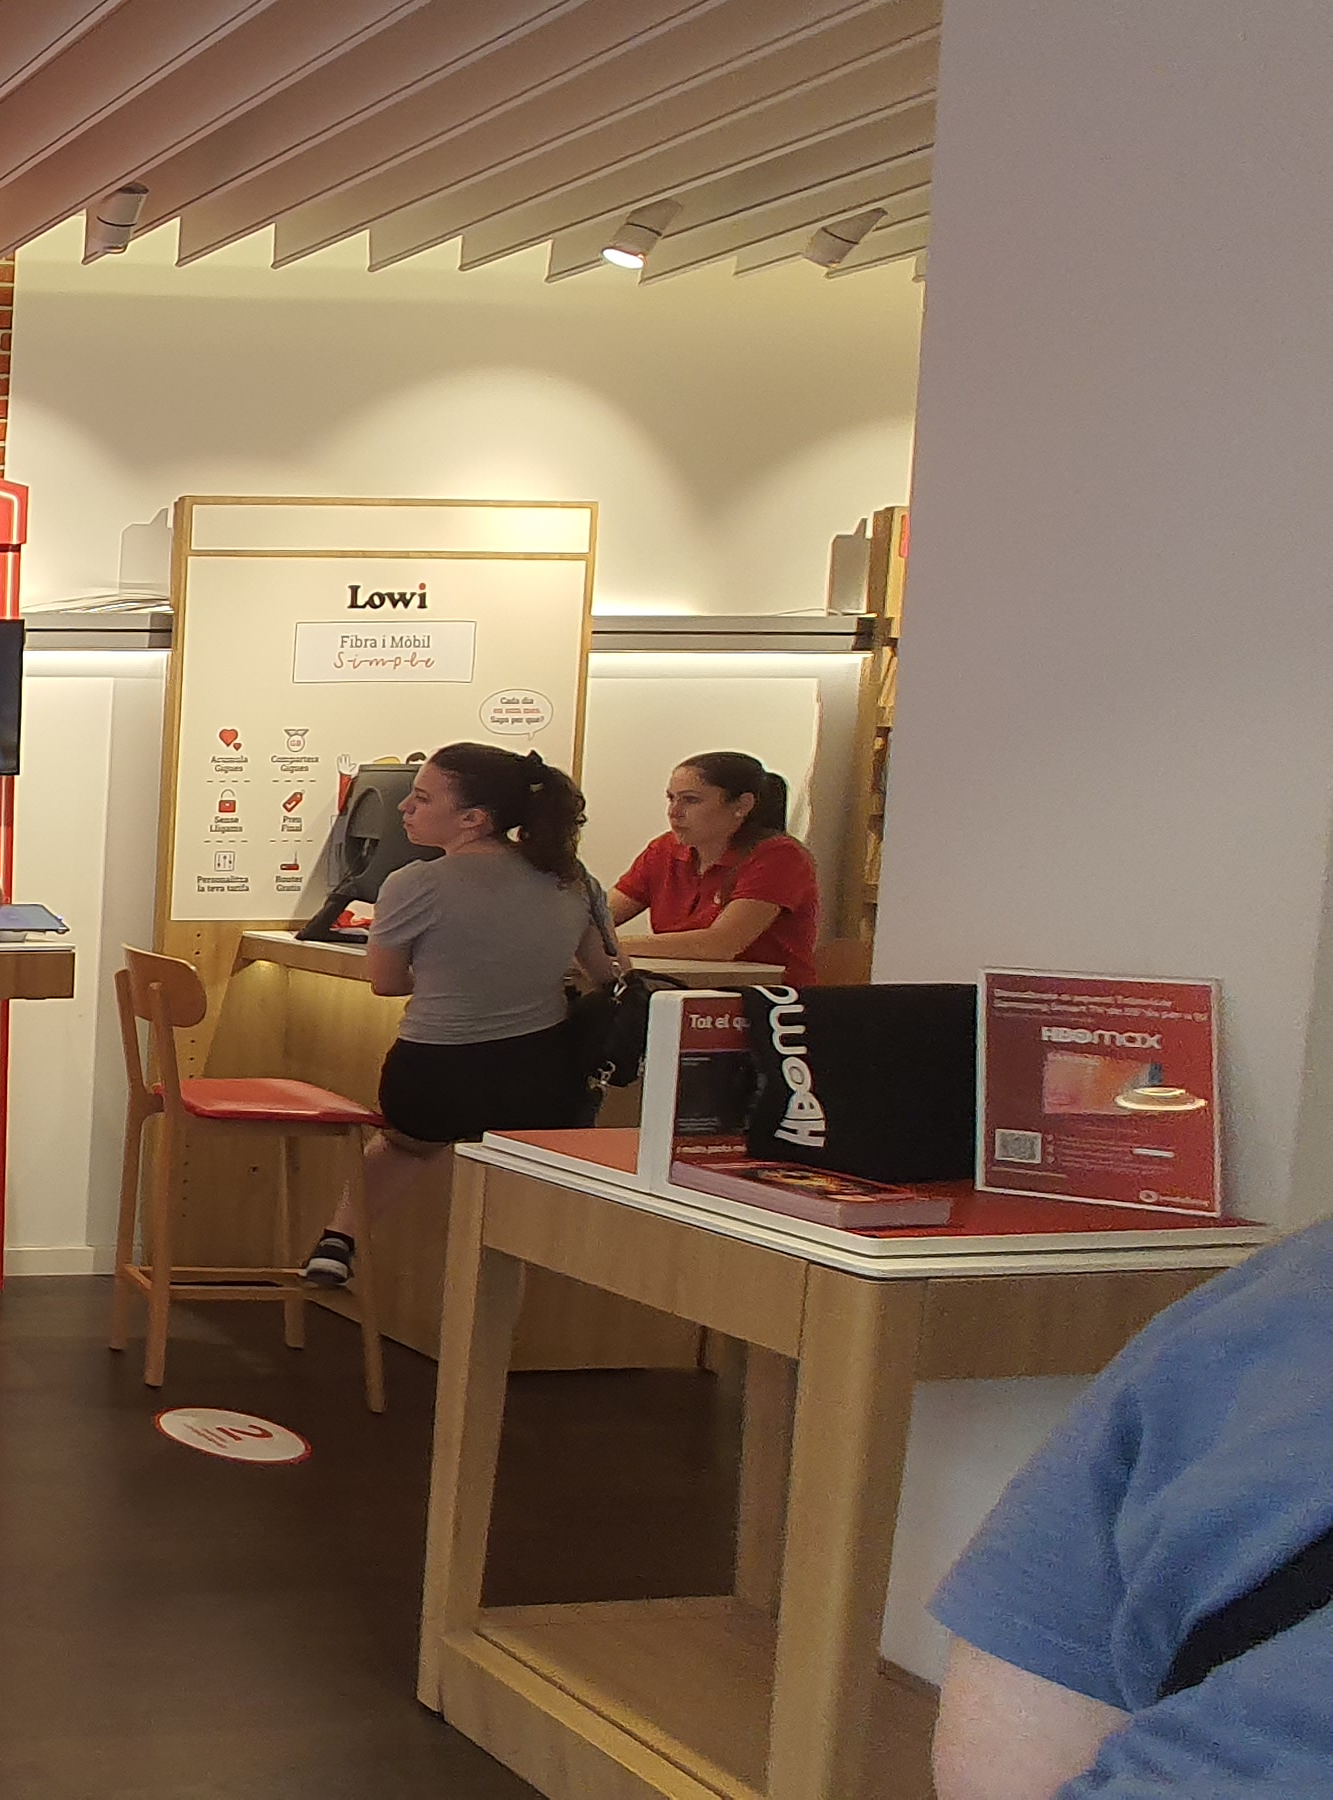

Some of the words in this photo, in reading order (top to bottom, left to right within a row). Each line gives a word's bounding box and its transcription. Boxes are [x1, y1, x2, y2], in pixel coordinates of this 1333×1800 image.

[347, 582, 428, 609] Lowi
[339, 635, 378, 649] Fibra
[381, 635, 387, 649] i
[390, 635, 432, 649] Mòbil
[521, 696, 534, 705] dia
[281, 824, 302, 832] Final
[275, 875, 303, 883] Router
[197, 884, 205, 892] la
